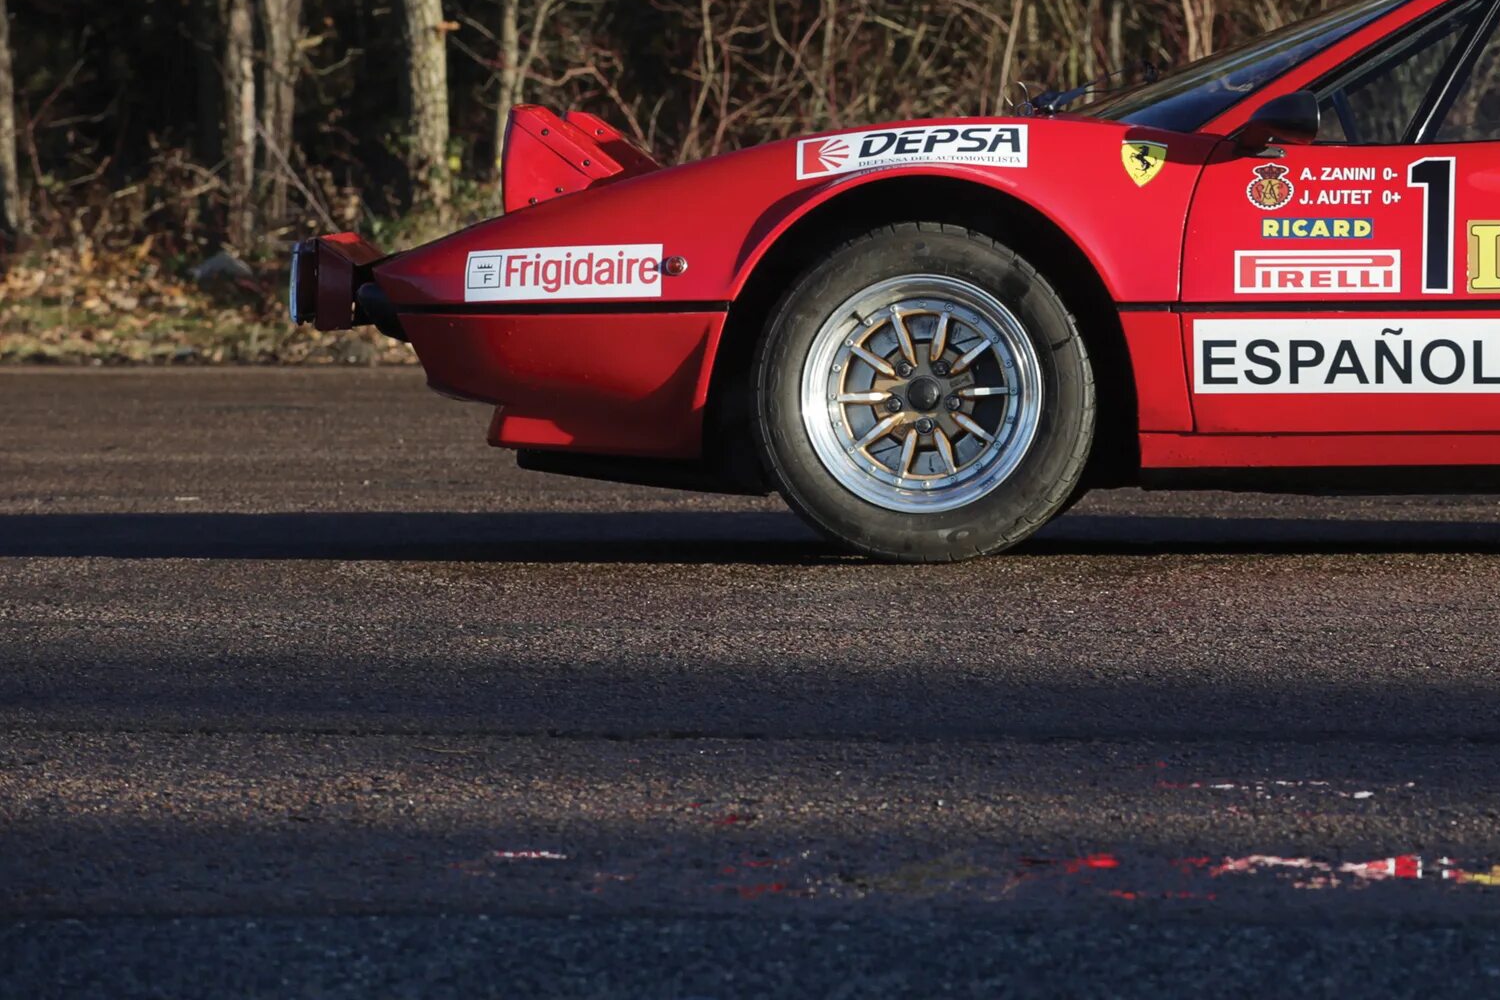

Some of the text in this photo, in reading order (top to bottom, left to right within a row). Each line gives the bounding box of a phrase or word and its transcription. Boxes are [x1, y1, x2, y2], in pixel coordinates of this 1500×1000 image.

[858, 127, 1021, 159] DEPSA
[858, 153, 1022, 168] DEFENSA DEL AUTOMOVILISTA
[1299, 167, 1317, 181] A.
[1320, 167, 1376, 181] ZANINI
[1299, 190, 1314, 205] J.
[1316, 190, 1373, 205] AUTET
[1262, 219, 1372, 237] RICARD
[1408, 159, 1454, 292] 1
[504, 250, 659, 293] Frigidaire
[1239, 254, 1395, 289] PIRELLI
